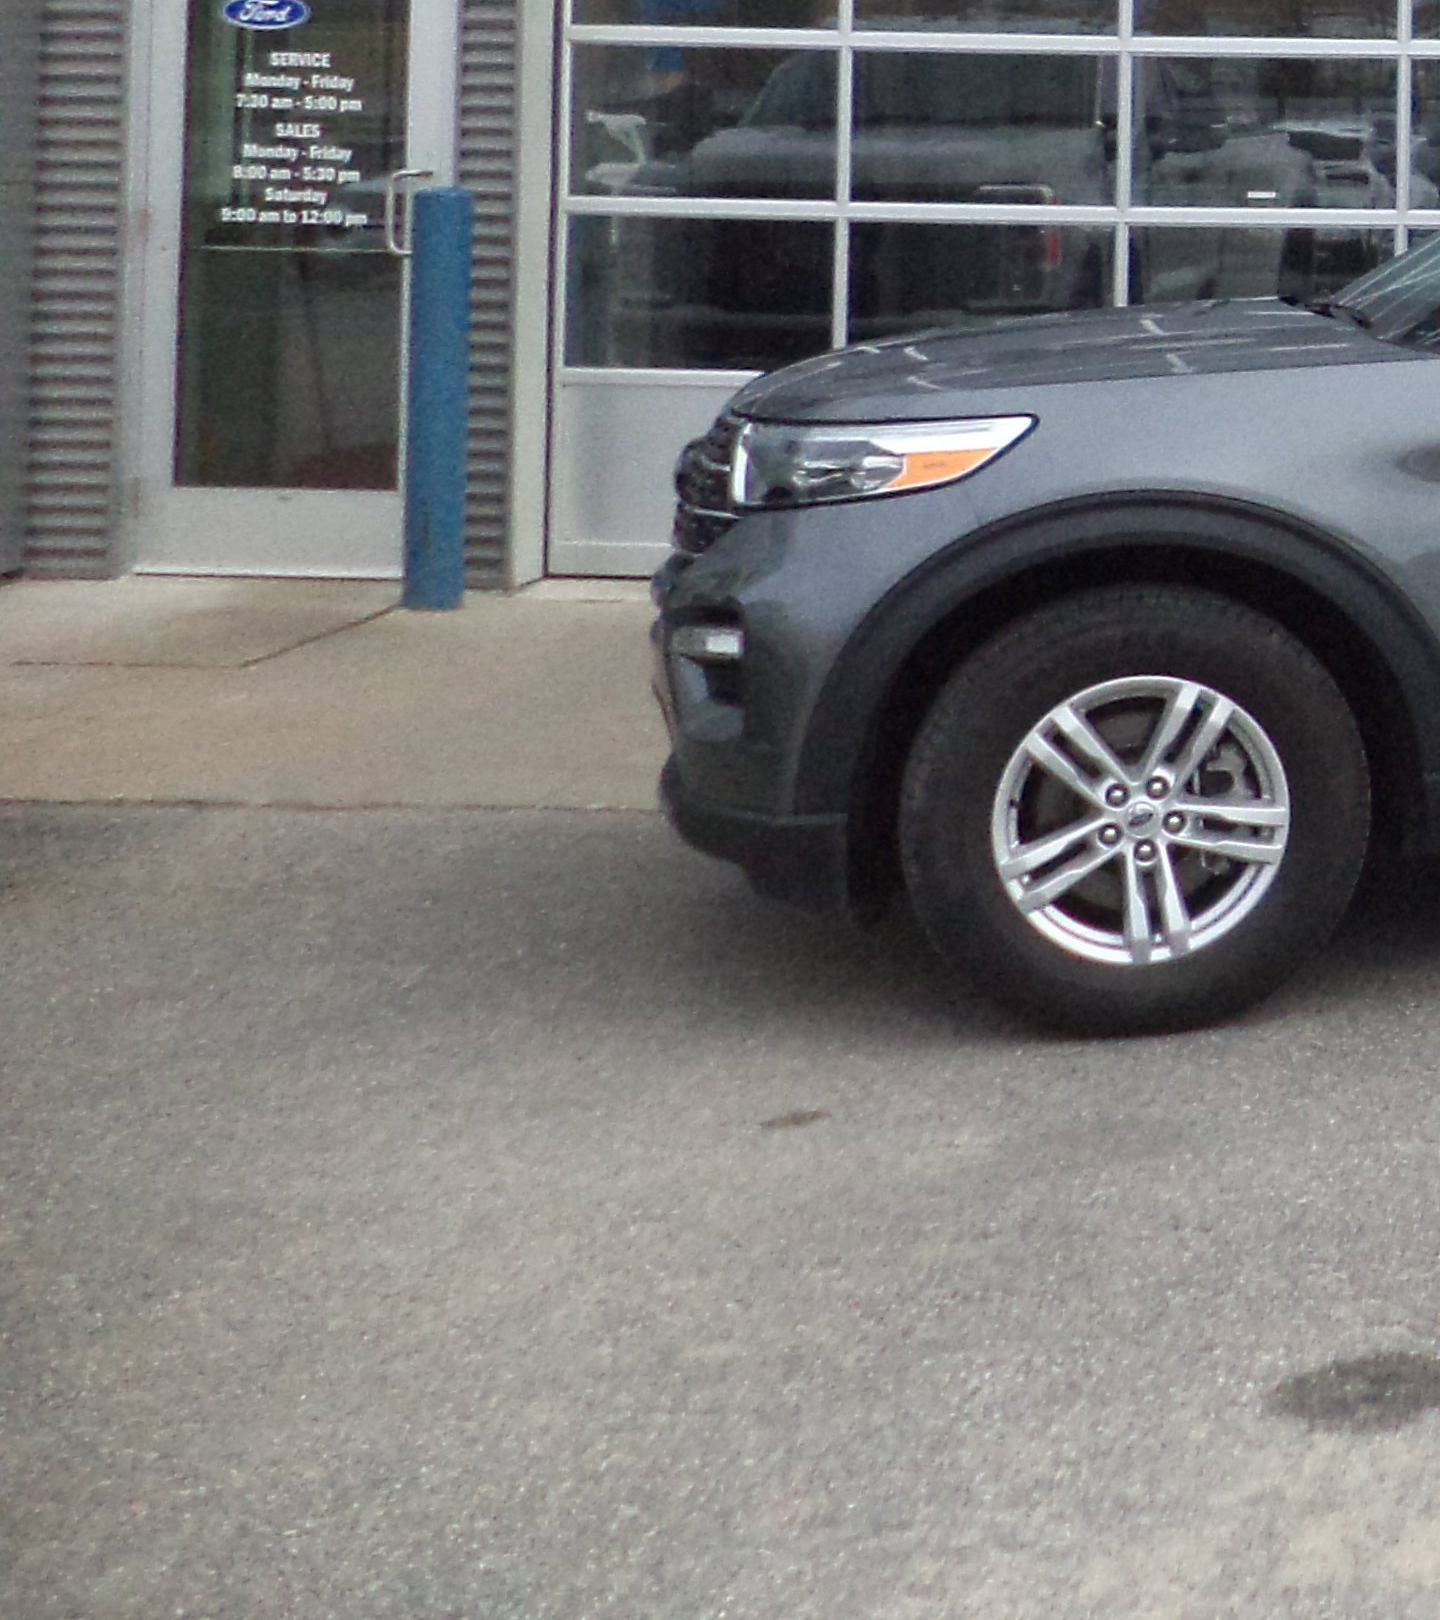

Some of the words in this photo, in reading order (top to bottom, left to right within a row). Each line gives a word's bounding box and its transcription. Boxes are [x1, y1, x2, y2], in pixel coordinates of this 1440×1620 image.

[270, 51, 332, 68] SERVICE
[243, 72, 301, 90] Monday
[311, 74, 355, 92] Friday
[235, 93, 269, 108] 7:30
[271, 97, 293, 109] am
[304, 95, 337, 110] 5:00
[340, 99, 363, 112] pm
[275, 123, 321, 138] SALES
[242, 144, 299, 162] Monday
[309, 146, 353, 163] Friday
[269, 169, 291, 180] am
[338, 171, 361, 184] pm
[264, 187, 328, 205] Saturday
[221, 208, 256, 222] 9:00
[258, 211, 280, 223] am
[283, 210, 297, 223] to
[300, 210, 343, 225] 12:00
[345, 214, 368, 227] pm
